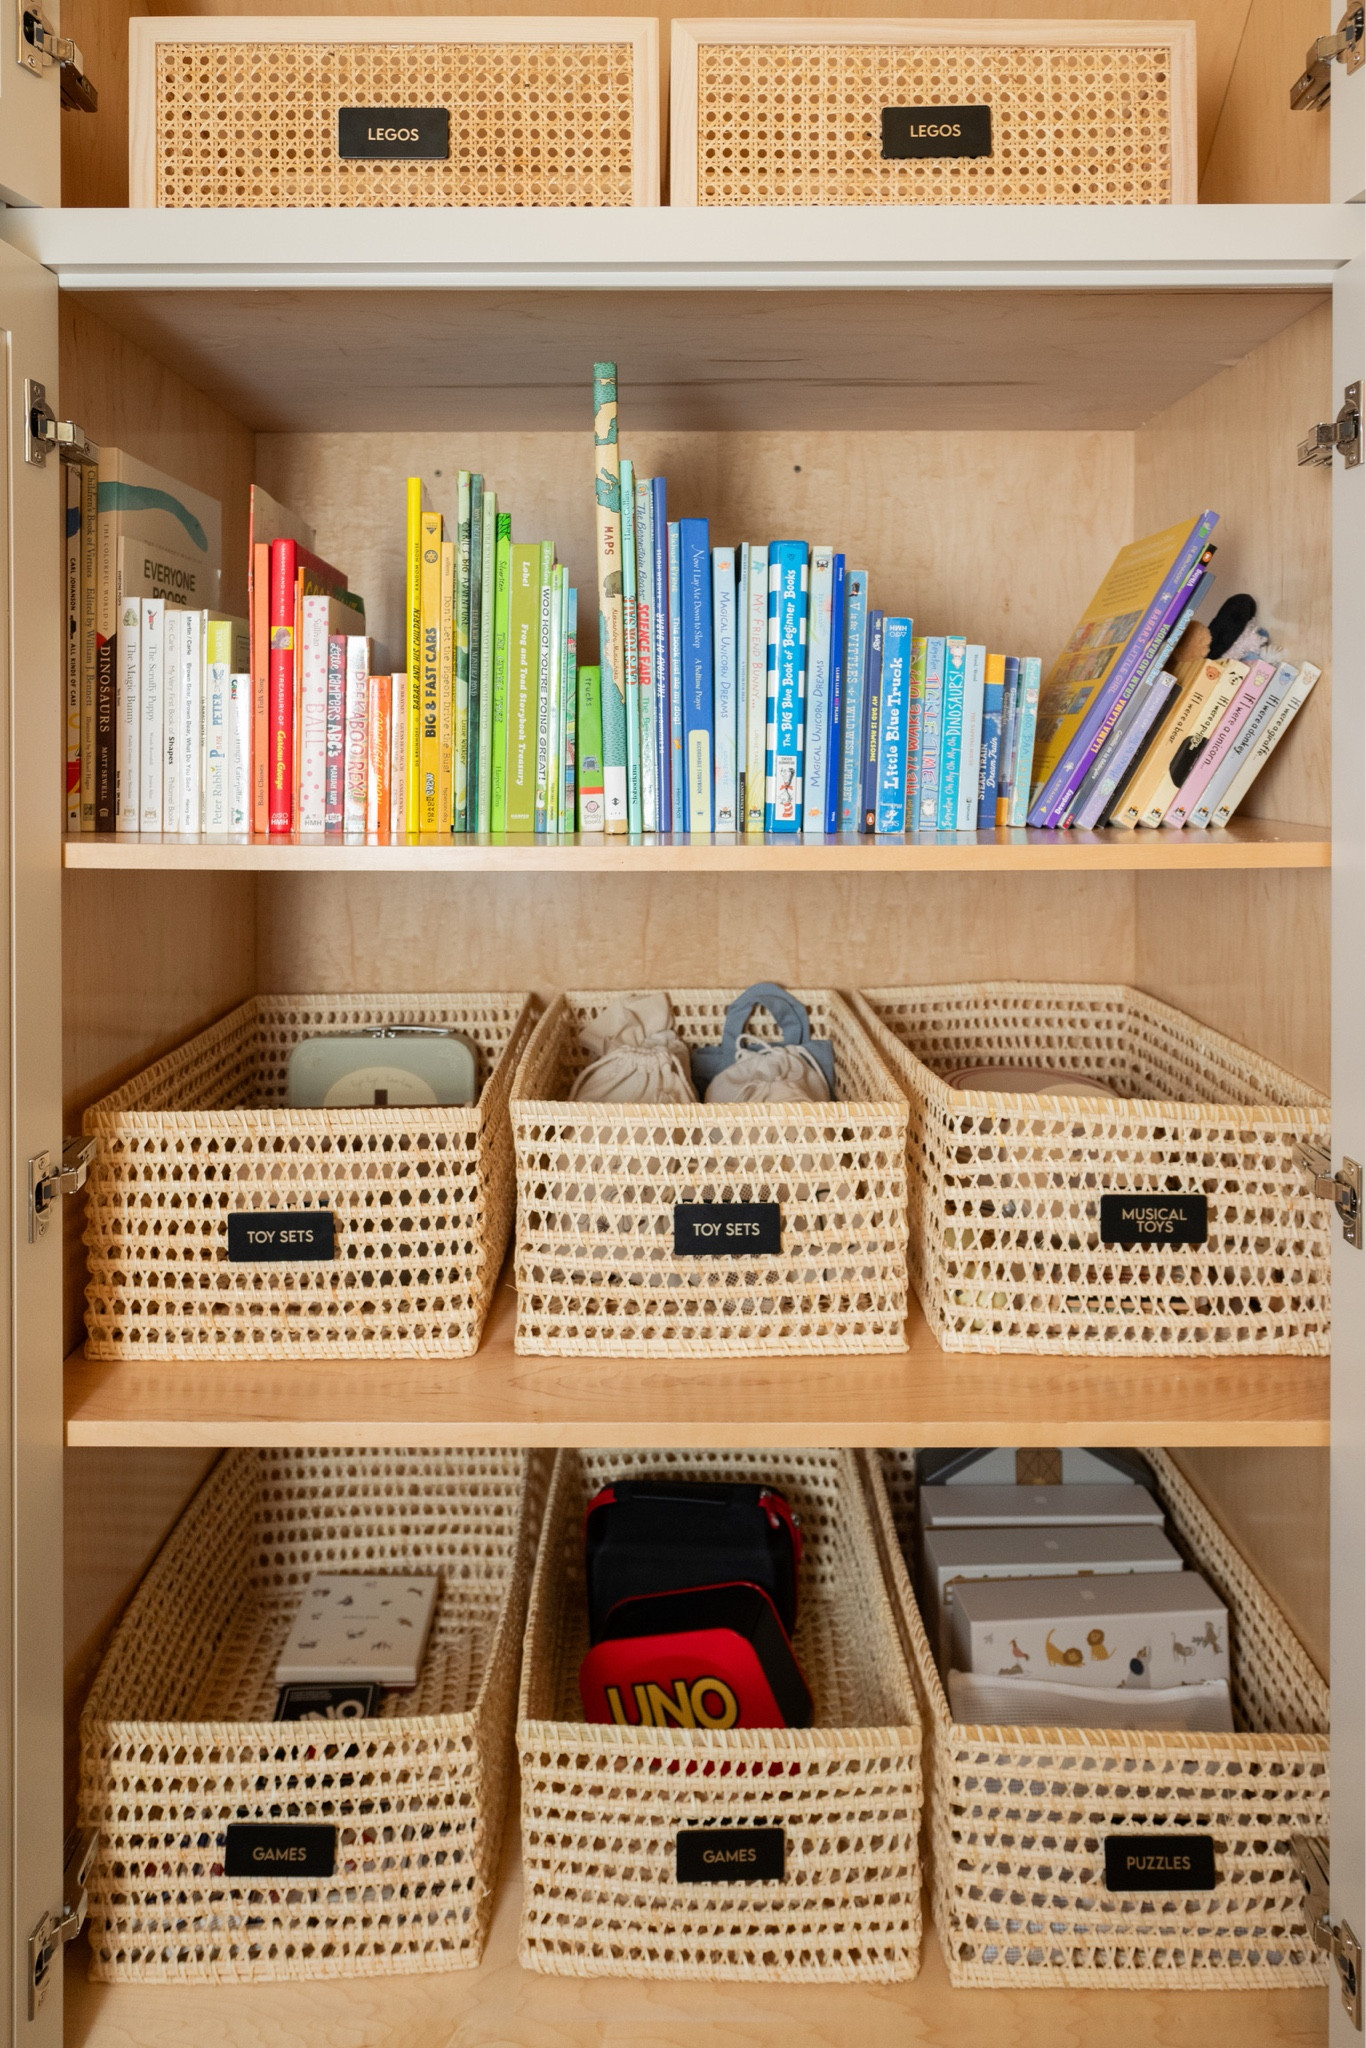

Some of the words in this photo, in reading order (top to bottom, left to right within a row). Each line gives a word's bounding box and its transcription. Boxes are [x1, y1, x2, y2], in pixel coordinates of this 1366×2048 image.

[368, 127, 420, 142] LEGOS
[910, 124, 961, 138] LEGOS
[87, 470, 96, 512] Children's
[623, 490, 632, 541] HarperCollins
[637, 503, 647, 519] The
[87, 515, 96, 535] Book
[87, 537, 96, 546] of
[604, 526, 614, 556] MAPS
[637, 522, 647, 568] Berenstain
[87, 548, 96, 578] Virtues
[691, 544, 704, 568] Now
[144, 559, 196, 592] EVERYONE
[522, 561, 531, 587] Lobel
[692, 574, 702, 586] Lay
[784, 570, 797, 600] Books
[87, 588, 95, 616] Edited
[542, 588, 550, 617] WOO
[693, 587, 702, 599] Me
[752, 594, 764, 613] MY
[850, 602, 860, 611] V
[443, 595, 452, 622] Don't
[624, 595, 637, 625] SALE
[693, 601, 702, 621] Down
[720, 592, 730, 633] MAGICAL
[85, 617, 95, 628] by
[313, 618, 322, 646] Sullivan
[443, 626, 452, 642] Let
[519, 624, 528, 645] Frog
[541, 619, 549, 648] HOO!
[638, 603, 650, 653] SCIENCE
[693, 622, 701, 630] to
[783, 602, 798, 647] Beginner
[1138, 608, 1162, 643] BABAR'S
[425, 628, 437, 663] CARS
[497, 632, 505, 650] THE
[624, 627, 637, 653] FOR
[691, 630, 702, 648] Sleep
[753, 619, 764, 656] FRIEND
[127, 642, 136, 661] The
[148, 645, 157, 661] The
[443, 646, 452, 661] the
[520, 648, 528, 665] and
[720, 637, 730, 679] UNICORN
[784, 650, 795, 660] of
[847, 634, 859, 685] VITTLES
[930, 640, 942, 670] Boynton
[1121, 645, 1140, 674] LITTLE
[125, 664, 136, 691] Magic
[147, 664, 157, 694] Scruffy
[495, 655, 504, 691] GIVING
[519, 668, 527, 690] Toad
[541, 652, 549, 693] YOU'RE
[625, 655, 638, 686] CAPS
[639, 657, 651, 686] FAIR
[672, 659, 681, 675] just
[783, 661, 795, 687] Book
[813, 661, 823, 697] DREAMS
[86, 674, 94, 706] Bennett
[100, 646, 111, 733] DINOSAURS
[425, 666, 437, 698] FAST
[442, 666, 451, 698] Pigeon
[586, 678, 594, 706] trucks
[657, 684, 665, 698] THE
[887, 657, 903, 706] Truck
[908, 670, 921, 698] UP!
[1054, 789, 1074, 815] Dewdney
[1091, 724, 1109, 754] LLAMA
[1107, 699, 1127, 728] LLAMA
[1123, 678, 1140, 700] GRAM
[1136, 658, 1150, 677] AND
[1145, 623, 1171, 659] GRANDPA
[1187, 568, 1203, 587] Viking
[1108, 675, 1123, 693] GIRL
[124, 696, 135, 725] Bunny
[146, 696, 156, 721] Puppy
[213, 693, 223, 725] PETER
[425, 701, 437, 711] &
[495, 695, 504, 722] TREE
[694, 691, 702, 710] Prayer
[720, 681, 731, 718] DREAMS
[782, 689, 792, 709] Blue
[923, 672, 942, 734] TICKLE
[947, 671, 963, 736] DINOSAURS!
[1181, 703, 1193, 720] were
[1243, 693, 1256, 704] If
[278, 716, 285, 726] OF
[305, 704, 325, 748] BALL
[349, 671, 365, 755] PEEKABOO
[425, 714, 437, 738] BIG
[443, 701, 452, 731] Drive
[517, 693, 527, 740] Storybook
[781, 712, 793, 732] BIG
[812, 701, 822, 742] UNICORN
[846, 706, 855, 730] WILD
[885, 708, 900, 742] Blue
[1208, 705, 1219, 723] were
[1230, 707, 1243, 726] were
[1257, 705, 1268, 720] were
[1279, 708, 1290, 726] were
[783, 734, 792, 747] The
[907, 704, 919, 751] WAKE
[277, 730, 286, 760] Curious
[443, 734, 452, 749] the
[845, 731, 855, 756] WEST
[946, 737, 956, 747] Oh
[946, 748, 956, 759] My
[988, 737, 998, 763] Train
[275, 762, 286, 790] George
[443, 753, 452, 773] Bus!
[516, 743, 526, 786] Treasury
[811, 746, 820, 787] MAGICAL
[884, 745, 899, 789] Little
[906, 756, 917, 795] HEY!
[922, 738, 939, 793] TIME!
[945, 760, 954, 771] Oh
[986, 765, 998, 788] Dream
[212, 765, 223, 796] Rabbit
[348, 761, 365, 797] REX!
[426, 773, 435, 797] CREW
[844, 758, 854, 803] ALPHABET
[945, 771, 955, 783] My
[945, 784, 954, 794] Oh
[978, 772, 987, 800] STEAM
[212, 799, 223, 825] Peter
[942, 798, 954, 827] Boynton
[1122, 1208, 1187, 1221] MUSICAL
[1136, 1220, 1174, 1234] TOYS
[247, 1230, 276, 1244] TOY
[279, 1229, 314, 1243] SETS
[693, 1223, 721, 1236] TOY
[725, 1222, 760, 1236] SETS
[606, 1677, 739, 1729] UNO
[252, 1847, 307, 1861] GAMES
[703, 1849, 757, 1863] GAMES
[1126, 1856, 1190, 1871] PUZZLES
